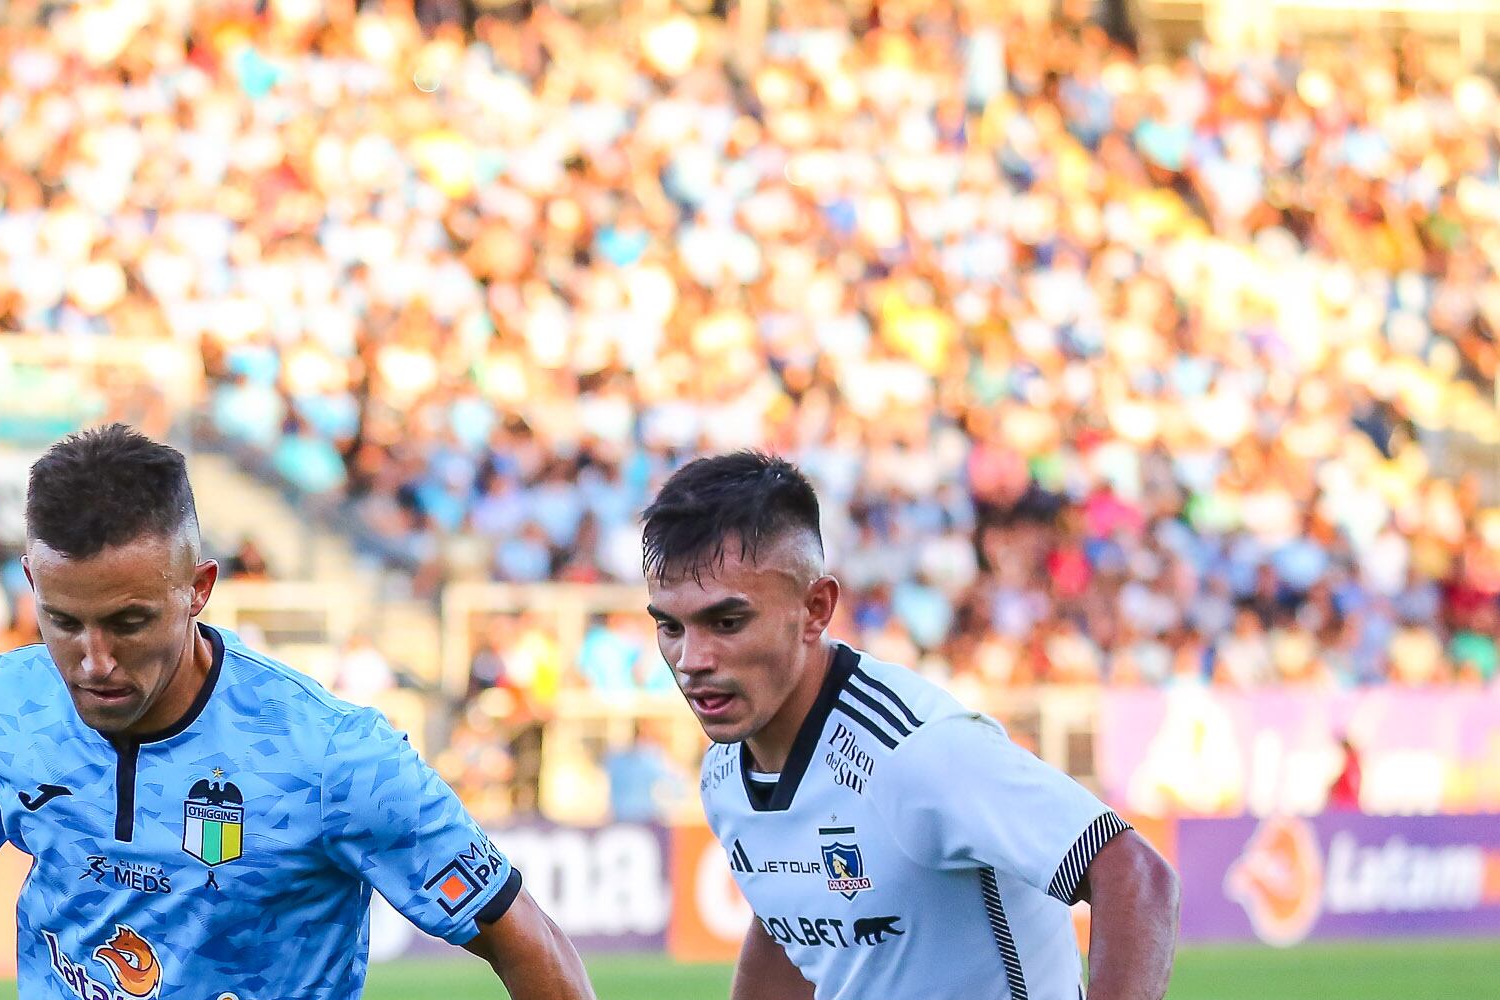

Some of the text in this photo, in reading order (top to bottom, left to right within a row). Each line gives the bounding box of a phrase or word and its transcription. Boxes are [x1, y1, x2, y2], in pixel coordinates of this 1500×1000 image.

[828, 722, 875, 777] Pilsen
[825, 752, 868, 796] del Sur
[188, 806, 239, 821] O'HIGGINS
[119, 860, 165, 875] CLINICA
[757, 861, 822, 874] JETOUR
[114, 867, 172, 893] MEDS
